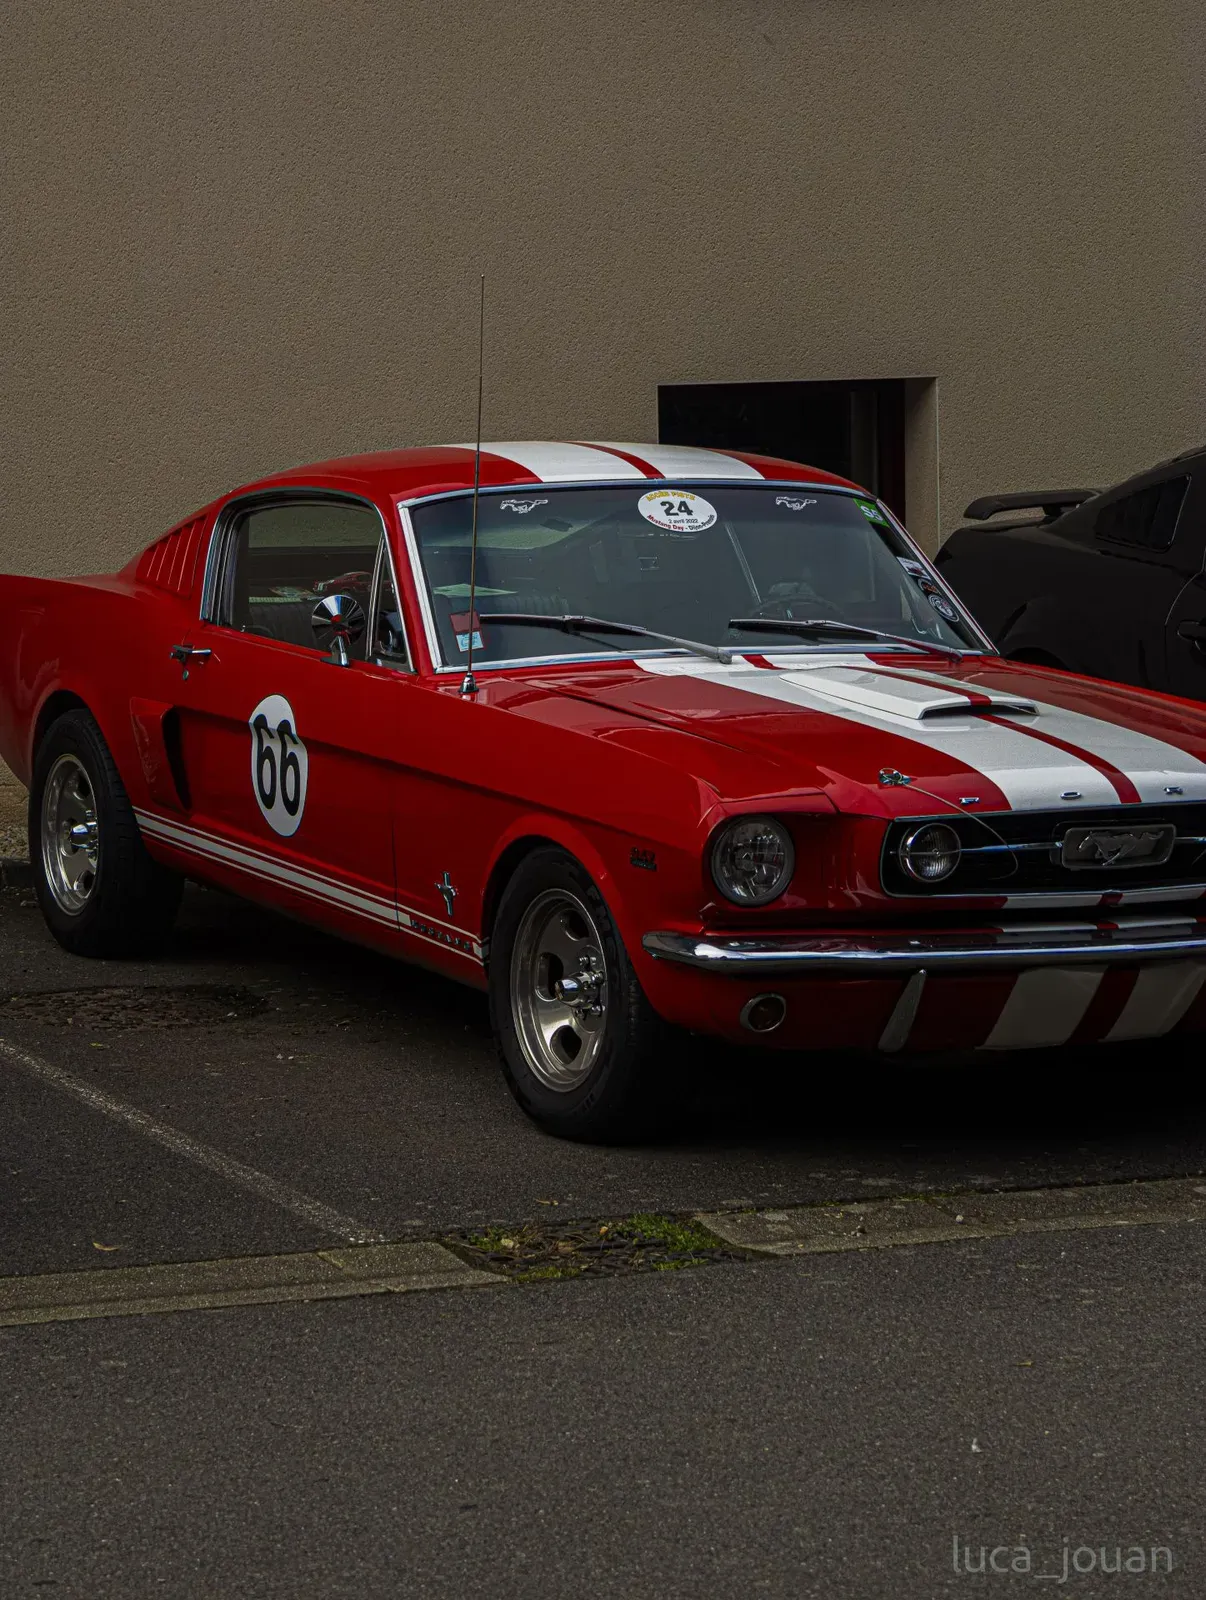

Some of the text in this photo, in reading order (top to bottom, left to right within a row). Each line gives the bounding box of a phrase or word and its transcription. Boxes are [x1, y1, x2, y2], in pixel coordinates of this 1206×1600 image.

[660, 500, 694, 517] 24
[646, 514, 672, 530] Mustang
[253, 713, 301, 817] 66
